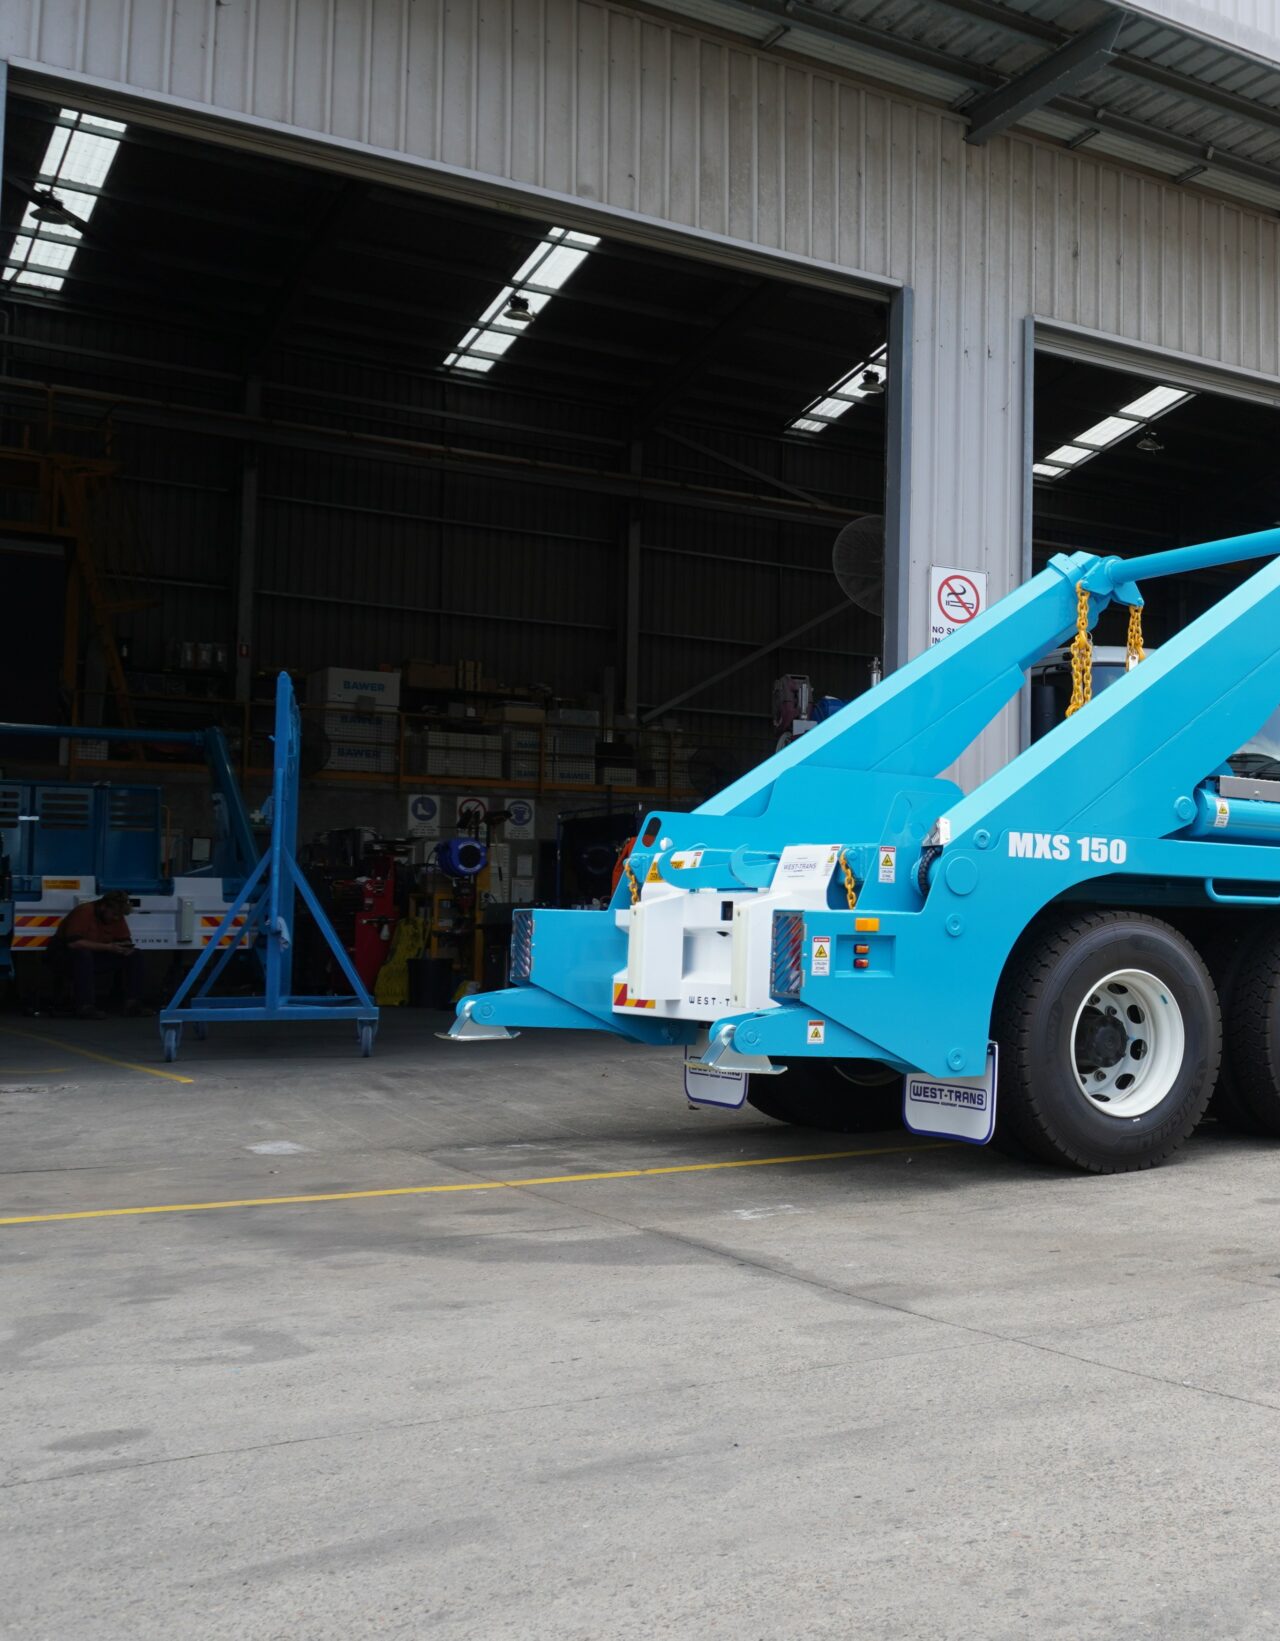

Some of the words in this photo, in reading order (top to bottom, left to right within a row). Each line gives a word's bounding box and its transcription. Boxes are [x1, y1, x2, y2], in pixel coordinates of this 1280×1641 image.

[932, 626, 945, 634] NO
[343, 680, 385, 692] BAWER
[337, 747, 381, 759] BAWER
[1008, 832, 1070, 860] MXS
[1077, 837, 1126, 864] 150
[689, 995, 730, 1007] WEST-T
[912, 1084, 984, 1106] WEST-TRANS
